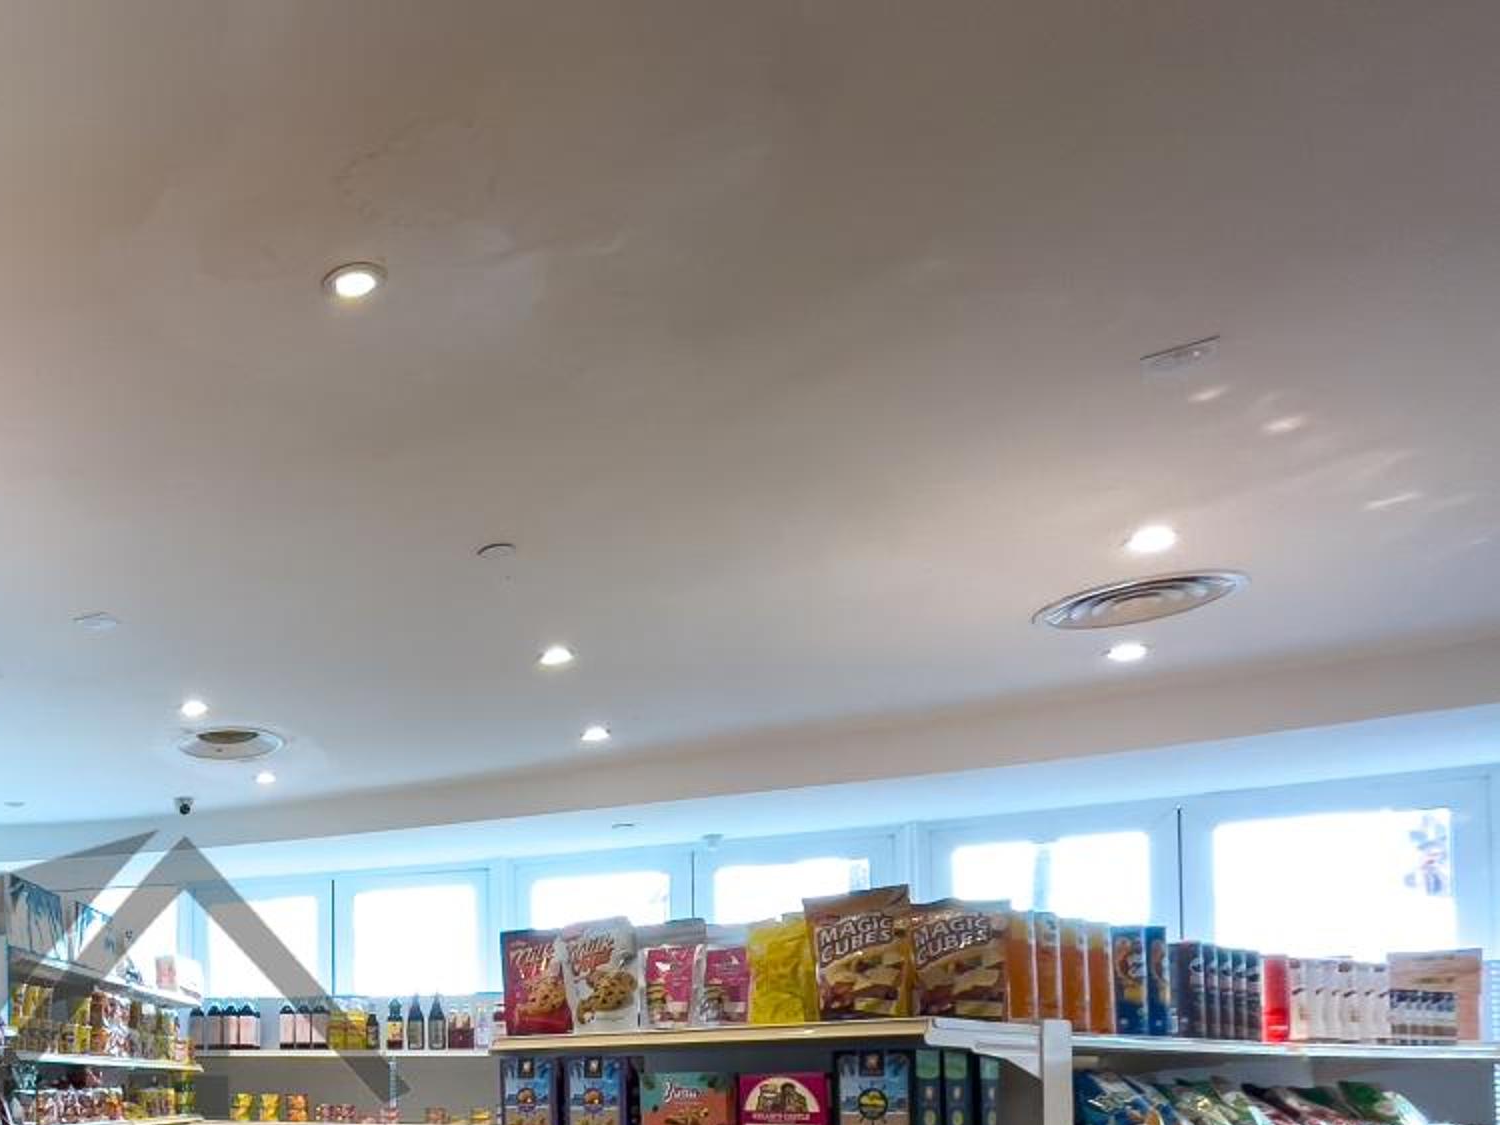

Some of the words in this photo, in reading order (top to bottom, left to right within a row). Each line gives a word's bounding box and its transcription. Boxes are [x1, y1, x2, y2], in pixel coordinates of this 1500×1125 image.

[820, 916, 893, 946] MAGIC
[820, 928, 892, 964] CUBES
[914, 915, 989, 947] MAGIC
[916, 930, 990, 966] CUBES
